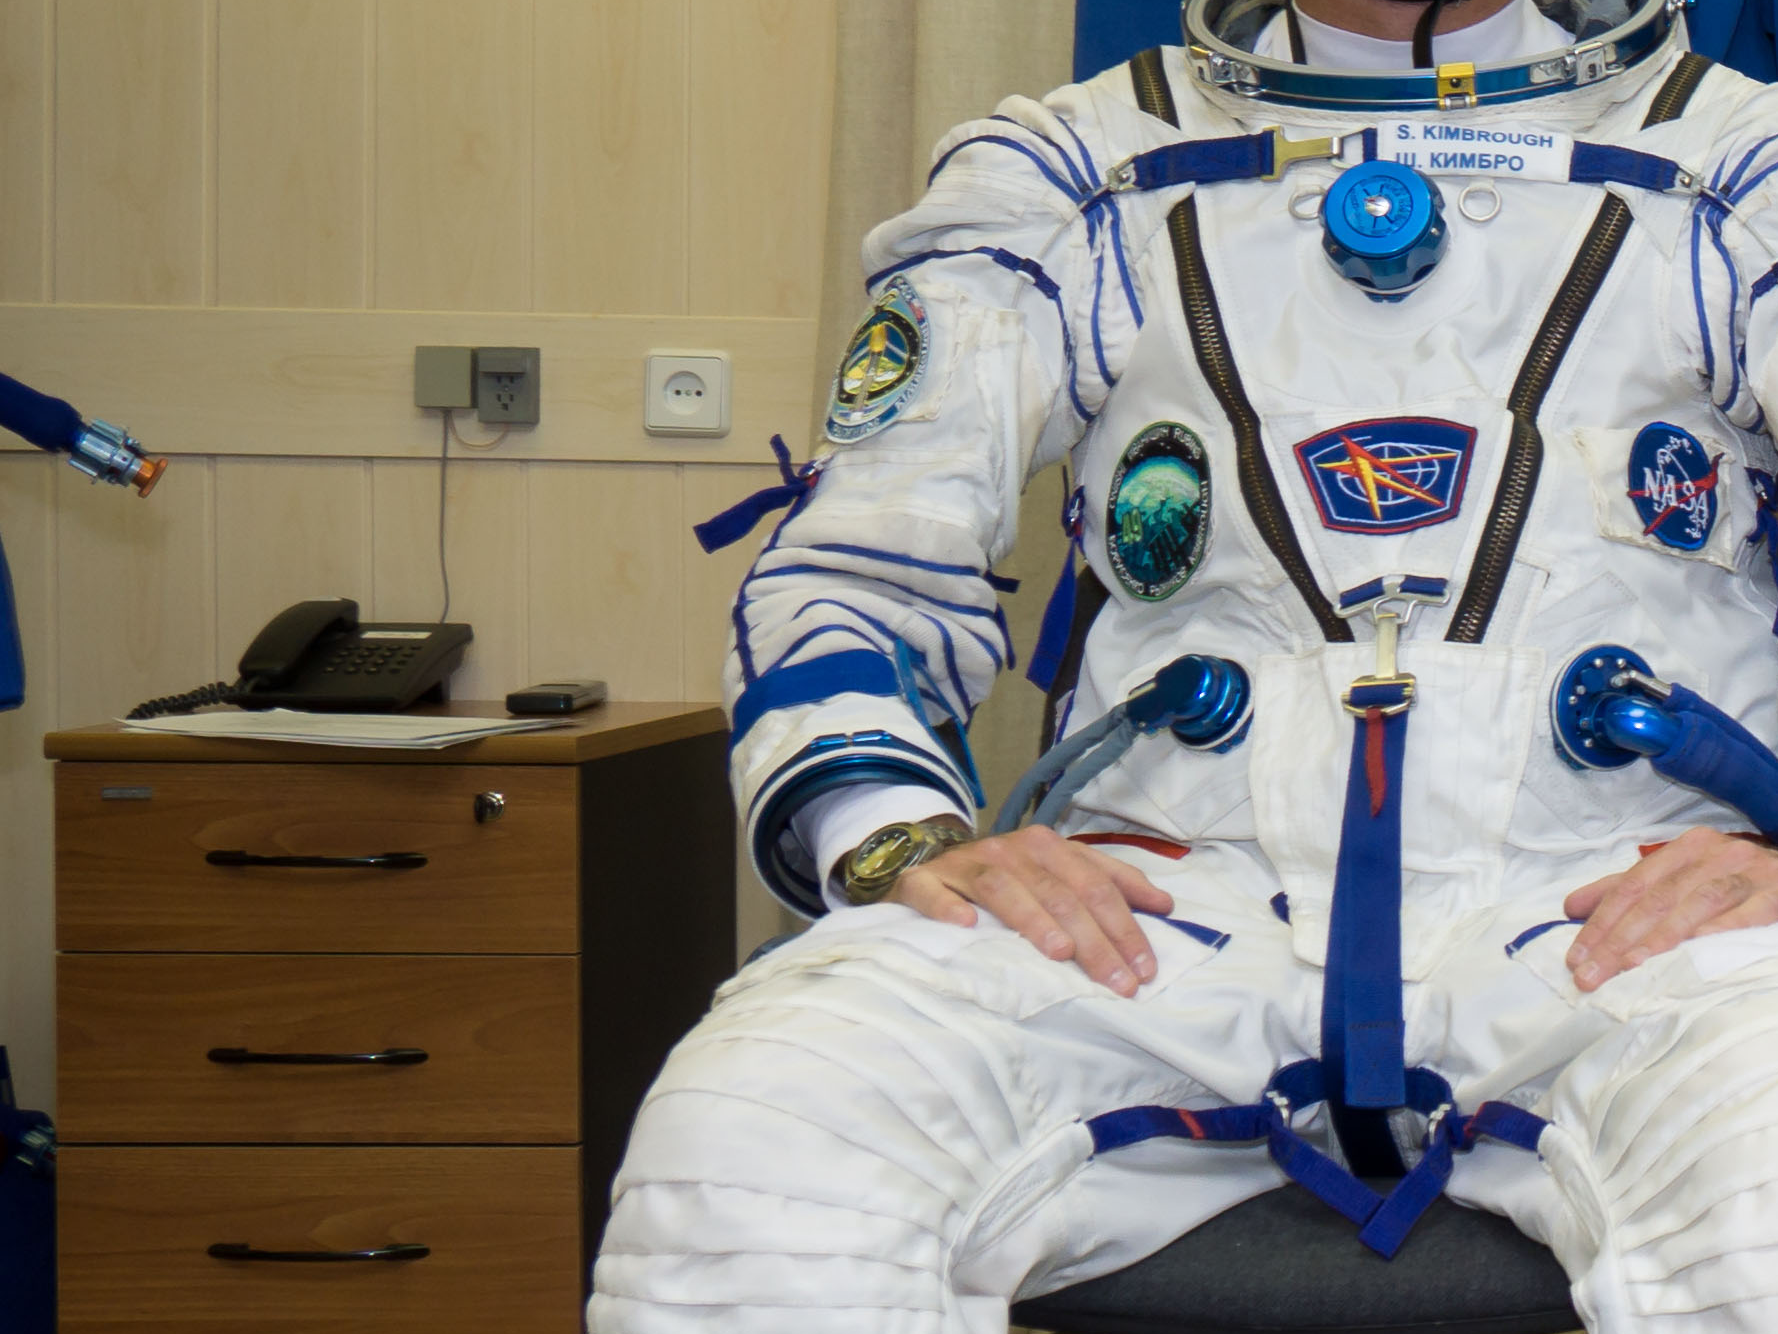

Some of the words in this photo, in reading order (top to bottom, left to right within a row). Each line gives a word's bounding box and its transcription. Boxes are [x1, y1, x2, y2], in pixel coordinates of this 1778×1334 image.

[1397, 125, 1415, 140] S.
[1423, 125, 1553, 148] KIMBROUGH
[1430, 152, 1525, 171] КИМБРО
[1643, 466, 1709, 530] NASA
